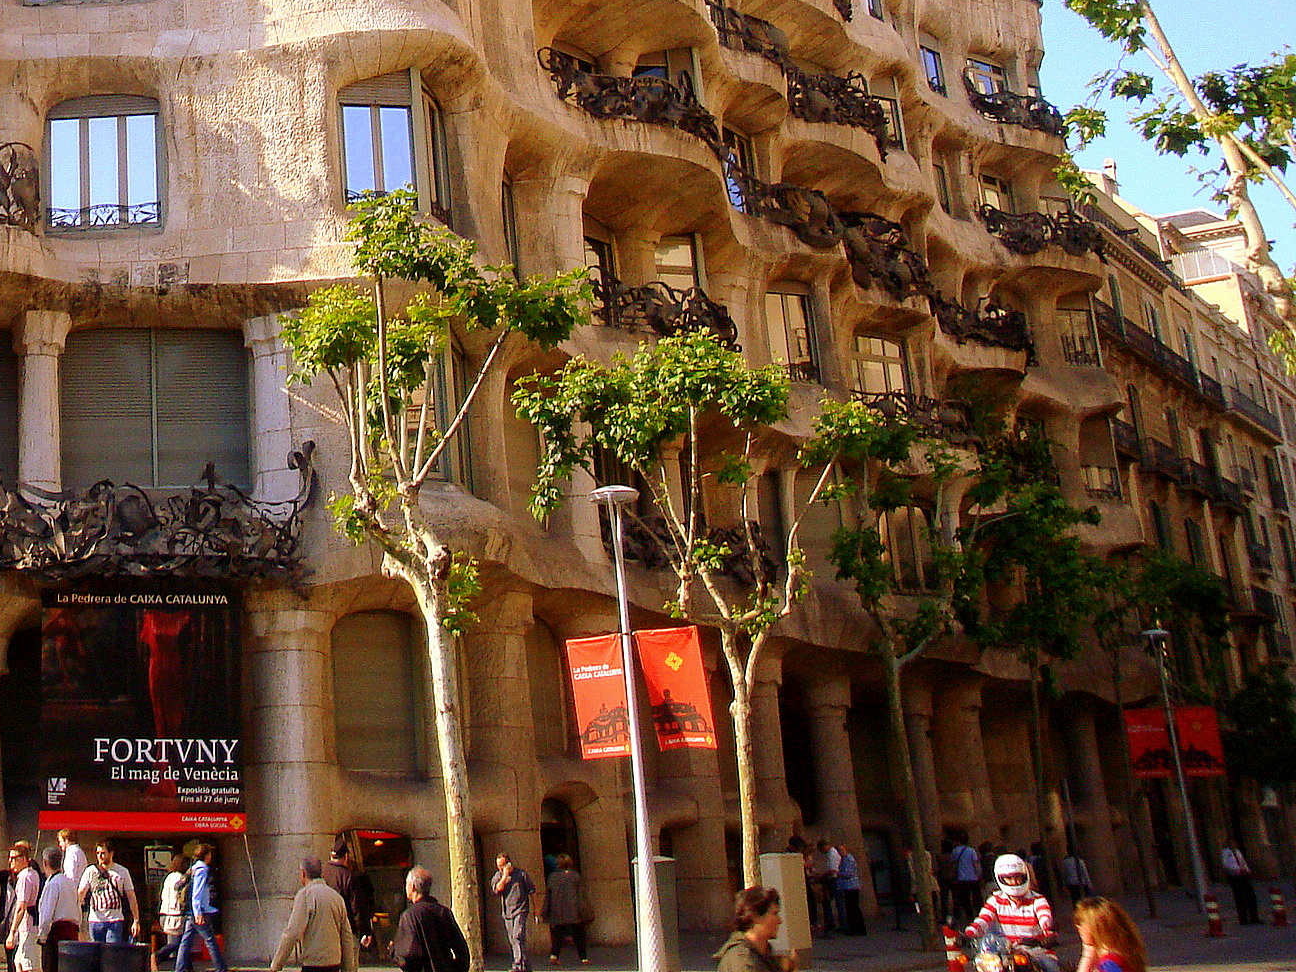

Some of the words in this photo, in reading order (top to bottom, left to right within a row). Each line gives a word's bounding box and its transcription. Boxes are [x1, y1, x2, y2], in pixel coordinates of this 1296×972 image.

[57, 593, 69, 603] La
[71, 593, 111, 604] Pedrera
[114, 593, 127, 604] de
[129, 594, 163, 605] CAIXA
[165, 594, 229, 605] CATALUNYA
[93, 738, 239, 764] FORTVNY
[111, 765, 124, 780] El
[128, 769, 160, 784] mag
[163, 766, 180, 780] de
[183, 766, 239, 781] Venècia
[177, 786, 210, 795] Exposició
[180, 795, 194, 803] Fins
[195, 795, 203, 803] al
[203, 795, 212, 803] 27
[224, 796, 240, 805] juny
